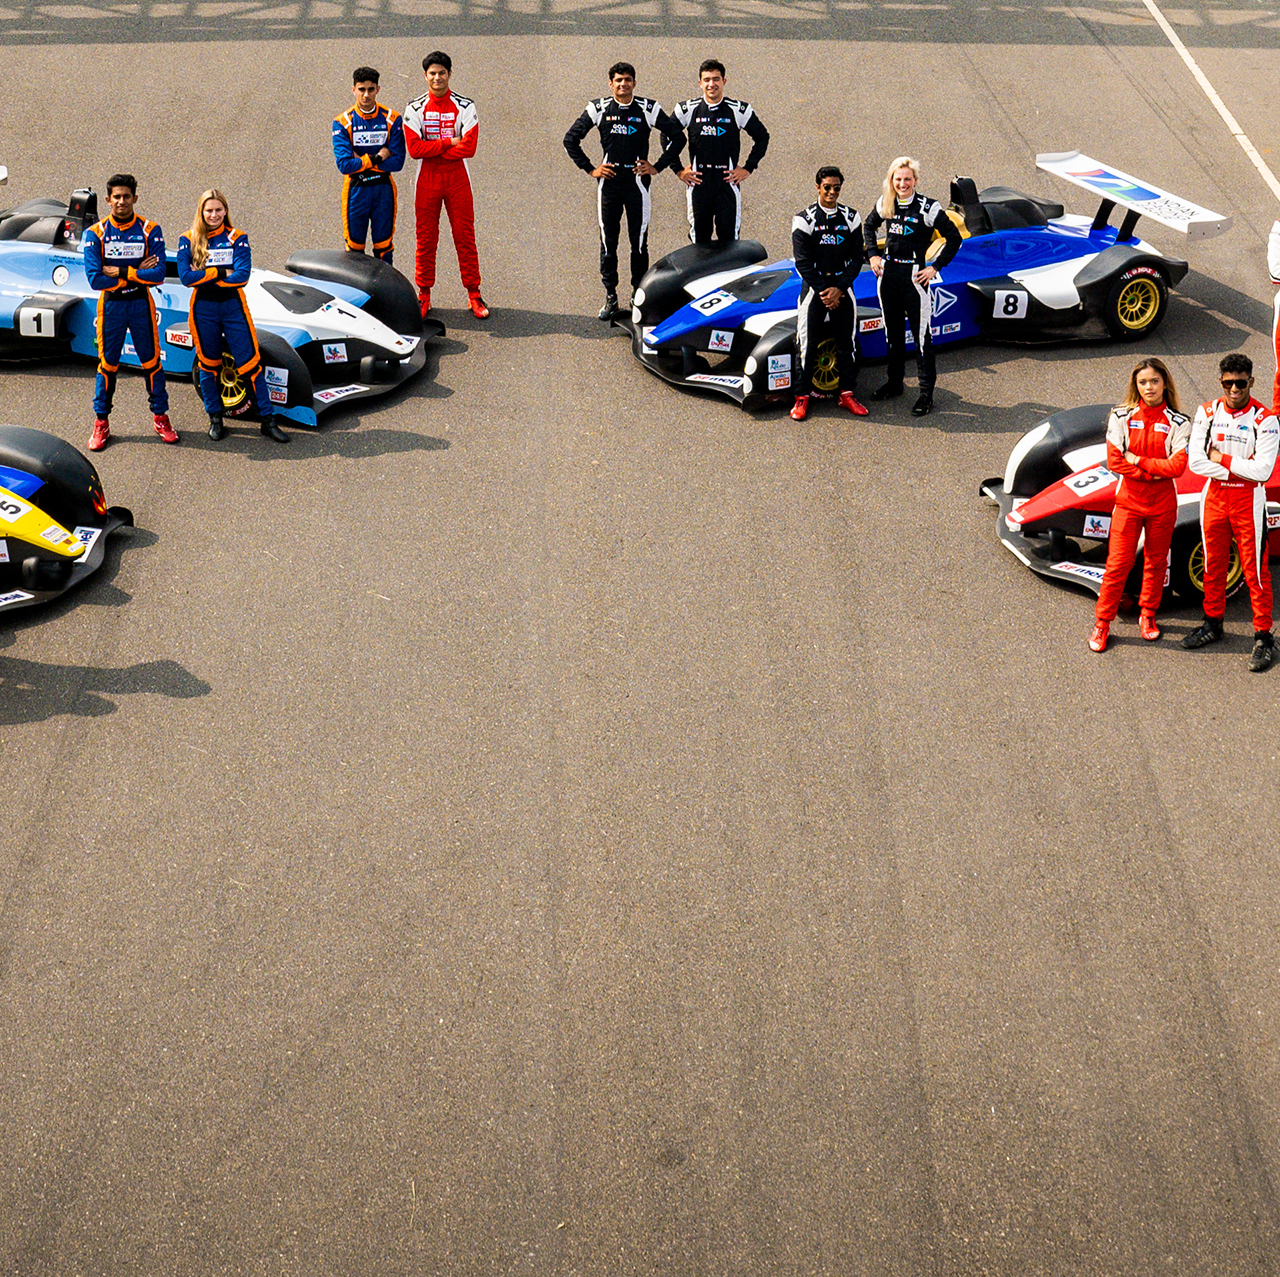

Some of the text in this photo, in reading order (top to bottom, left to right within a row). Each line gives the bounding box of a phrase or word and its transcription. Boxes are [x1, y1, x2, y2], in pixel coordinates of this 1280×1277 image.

[700, 298, 721, 310] 8
[1002, 293, 1018, 315] 8
[32, 312, 43, 334] 1
[863, 320, 881, 329] MRF
[170, 333, 189, 344] MRF
[1074, 475, 1098, 489] 3
